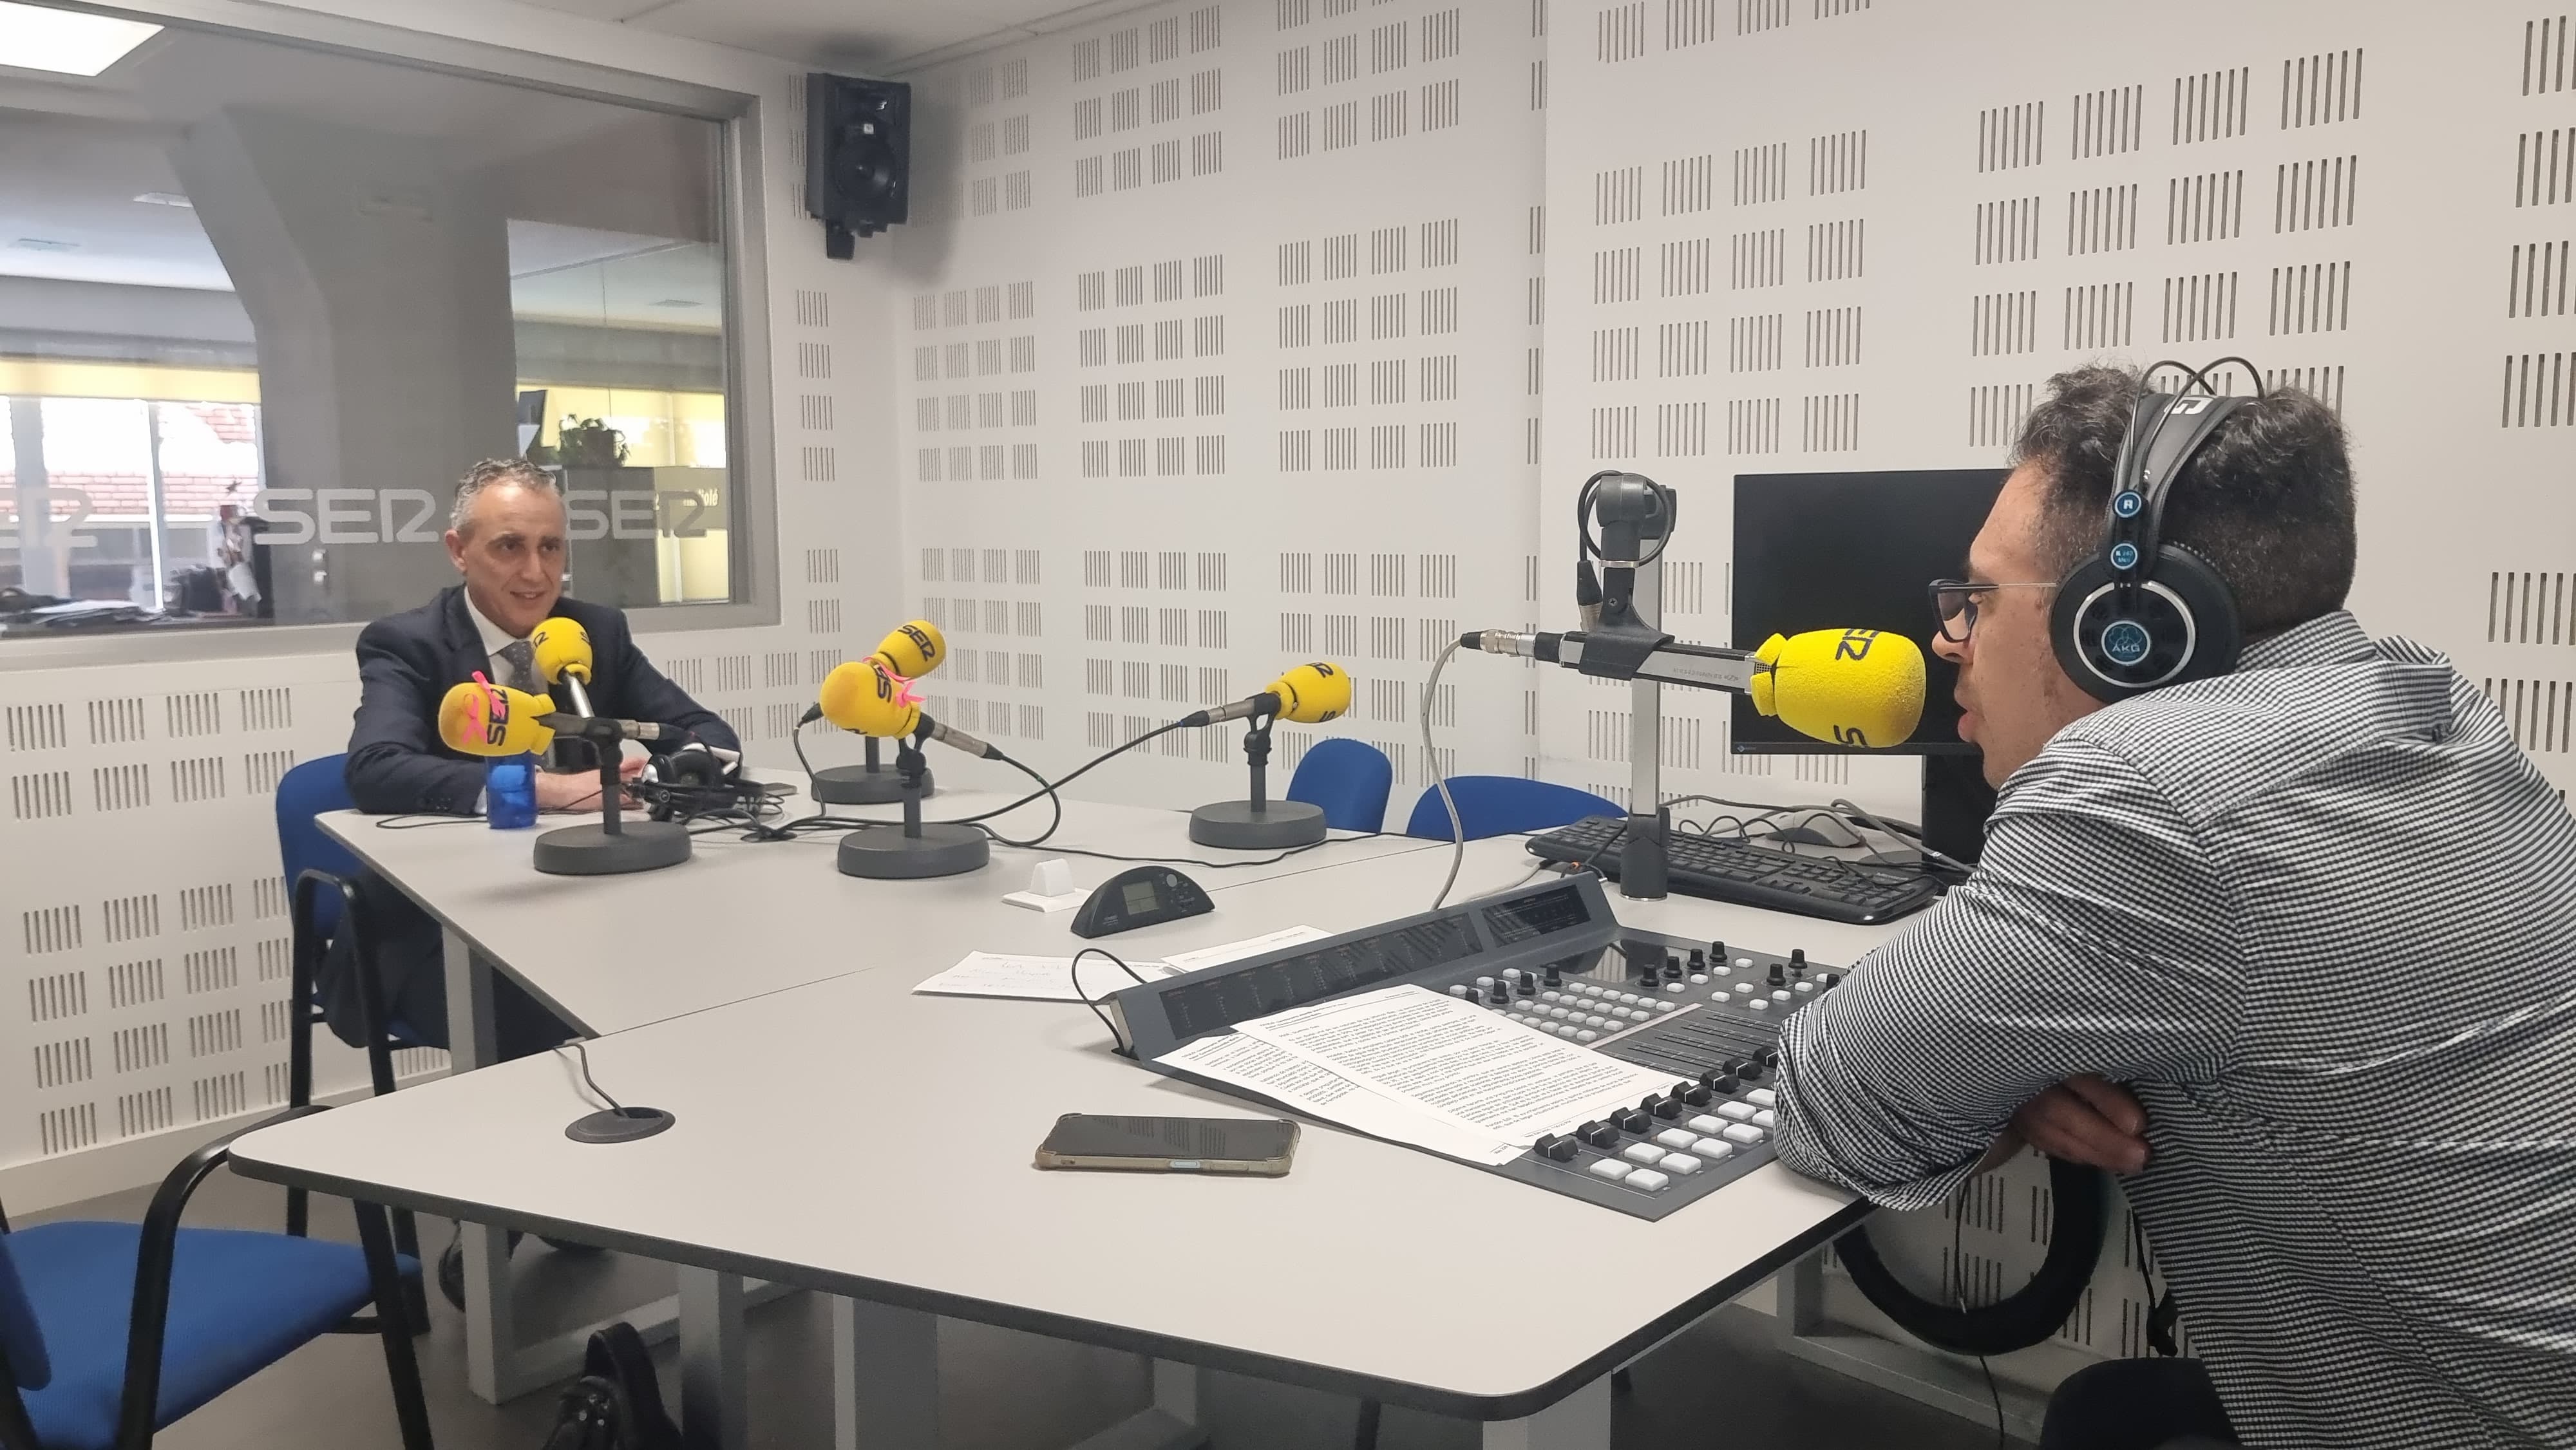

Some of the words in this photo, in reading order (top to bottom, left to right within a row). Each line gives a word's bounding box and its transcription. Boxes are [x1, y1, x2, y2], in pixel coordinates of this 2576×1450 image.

[253, 488, 439, 545] SER
[563, 489, 708, 540] SER
[897, 625, 936, 662] SER
[2112, 644, 2141, 654] AKG
